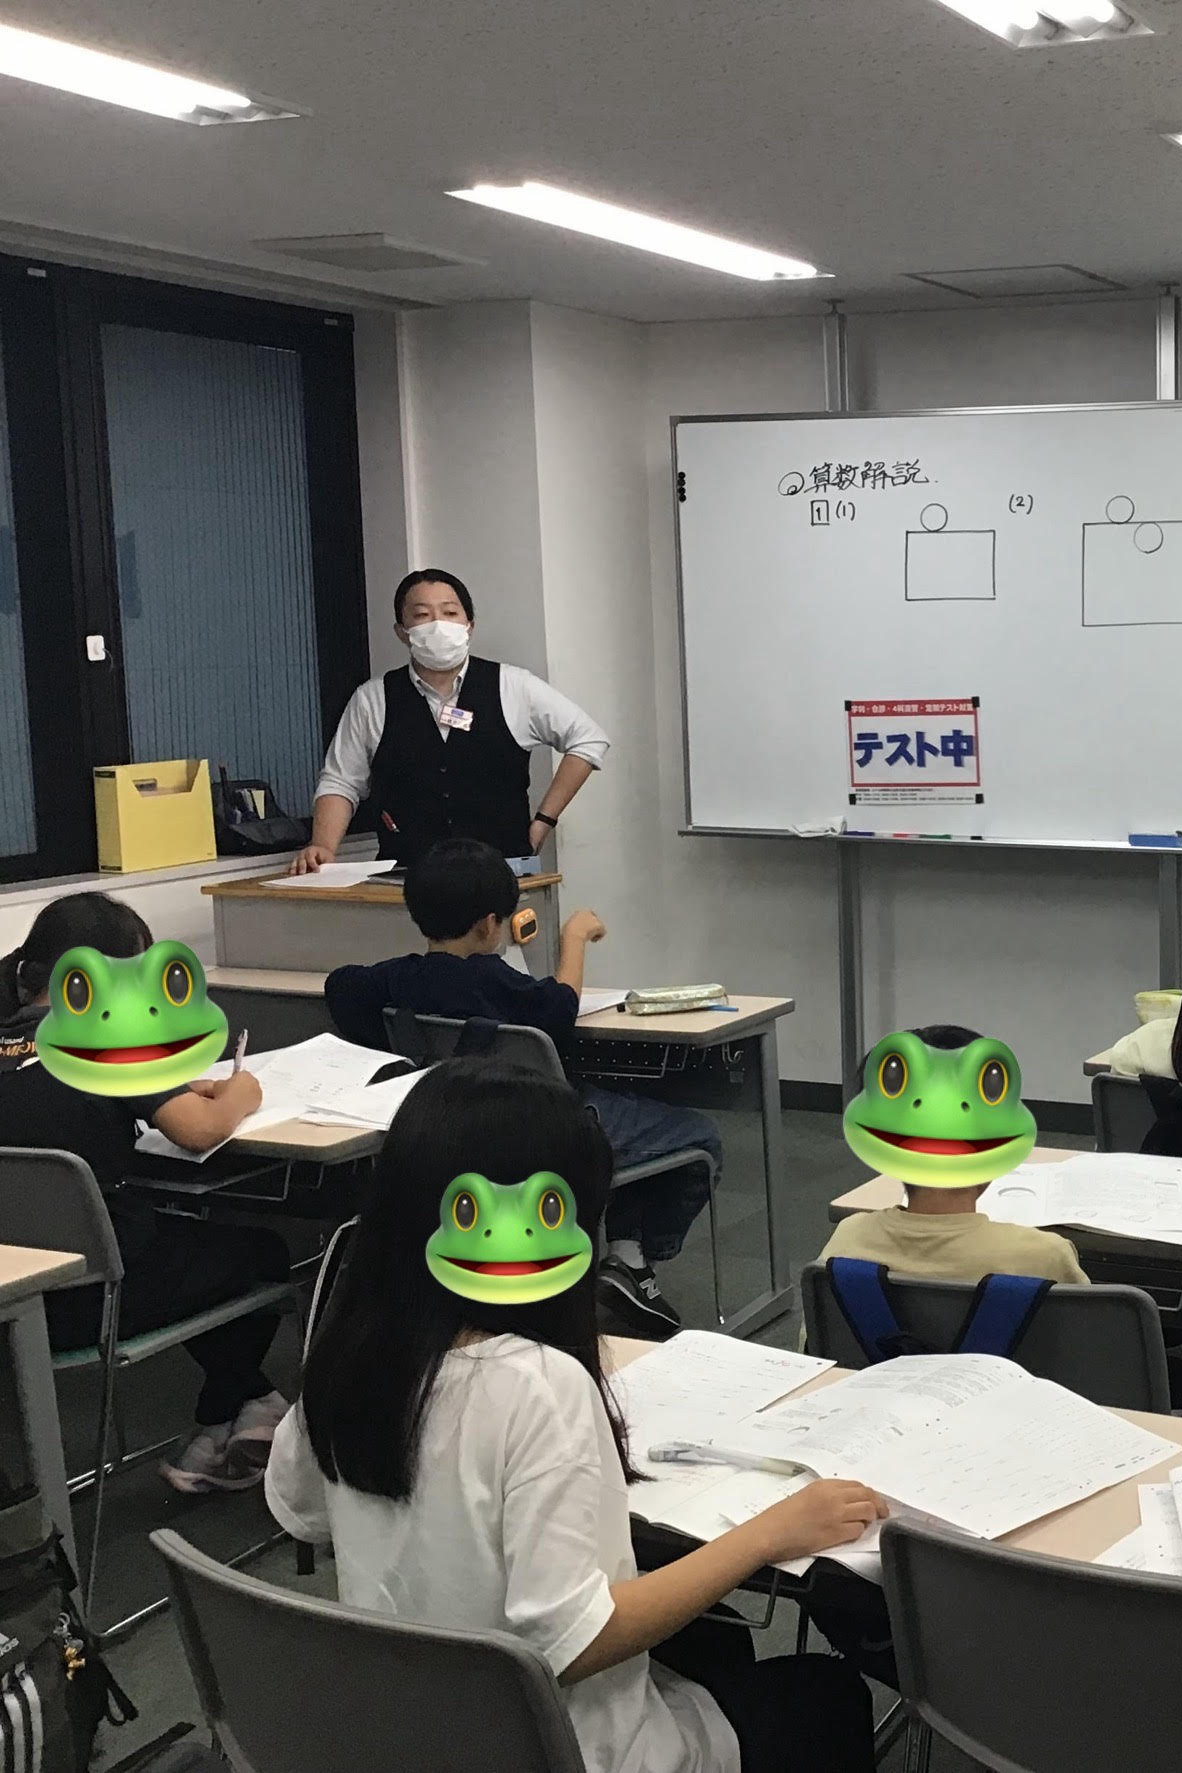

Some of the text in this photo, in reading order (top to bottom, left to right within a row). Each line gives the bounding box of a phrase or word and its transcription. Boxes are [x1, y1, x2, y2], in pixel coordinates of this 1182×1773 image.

[1009, 494, 1034, 515] (2)
[854, 729, 976, 768] テスト中
